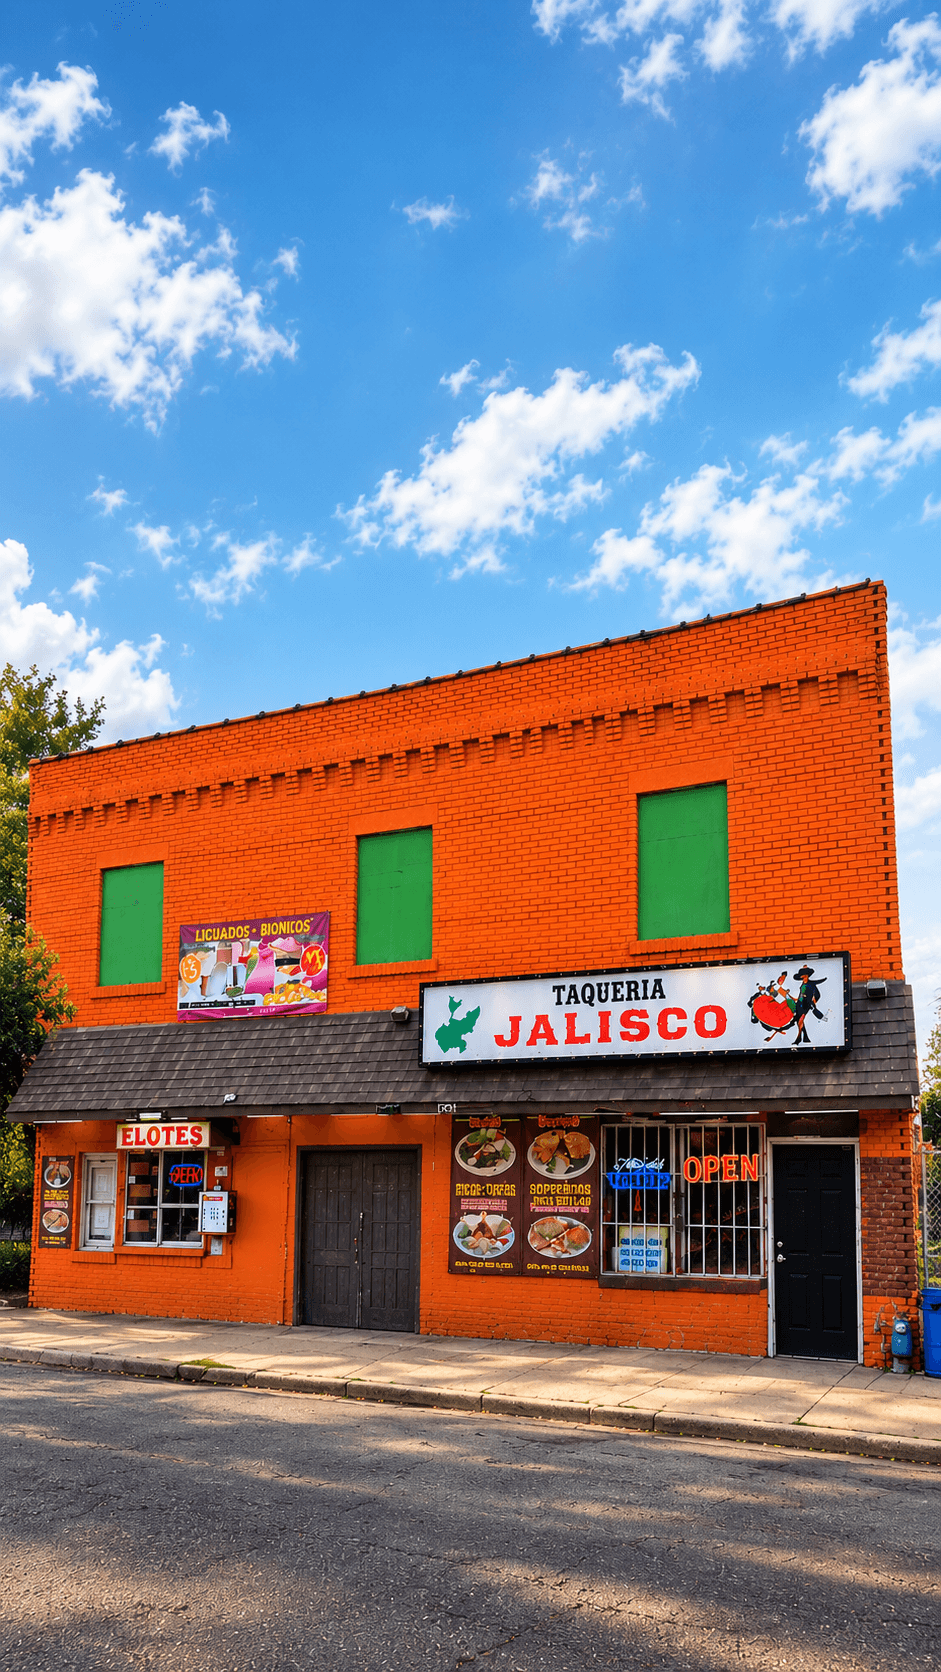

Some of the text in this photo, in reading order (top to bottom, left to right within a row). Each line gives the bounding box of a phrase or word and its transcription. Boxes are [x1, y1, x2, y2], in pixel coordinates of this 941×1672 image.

[195, 919, 311, 942] LICUADOS BIONICOS
[552, 978, 666, 1007] TAQUERIA
[493, 1005, 728, 1047] JALISCO
[121, 1125, 203, 1146] ELOTES
[683, 1153, 760, 1183] OPEN
